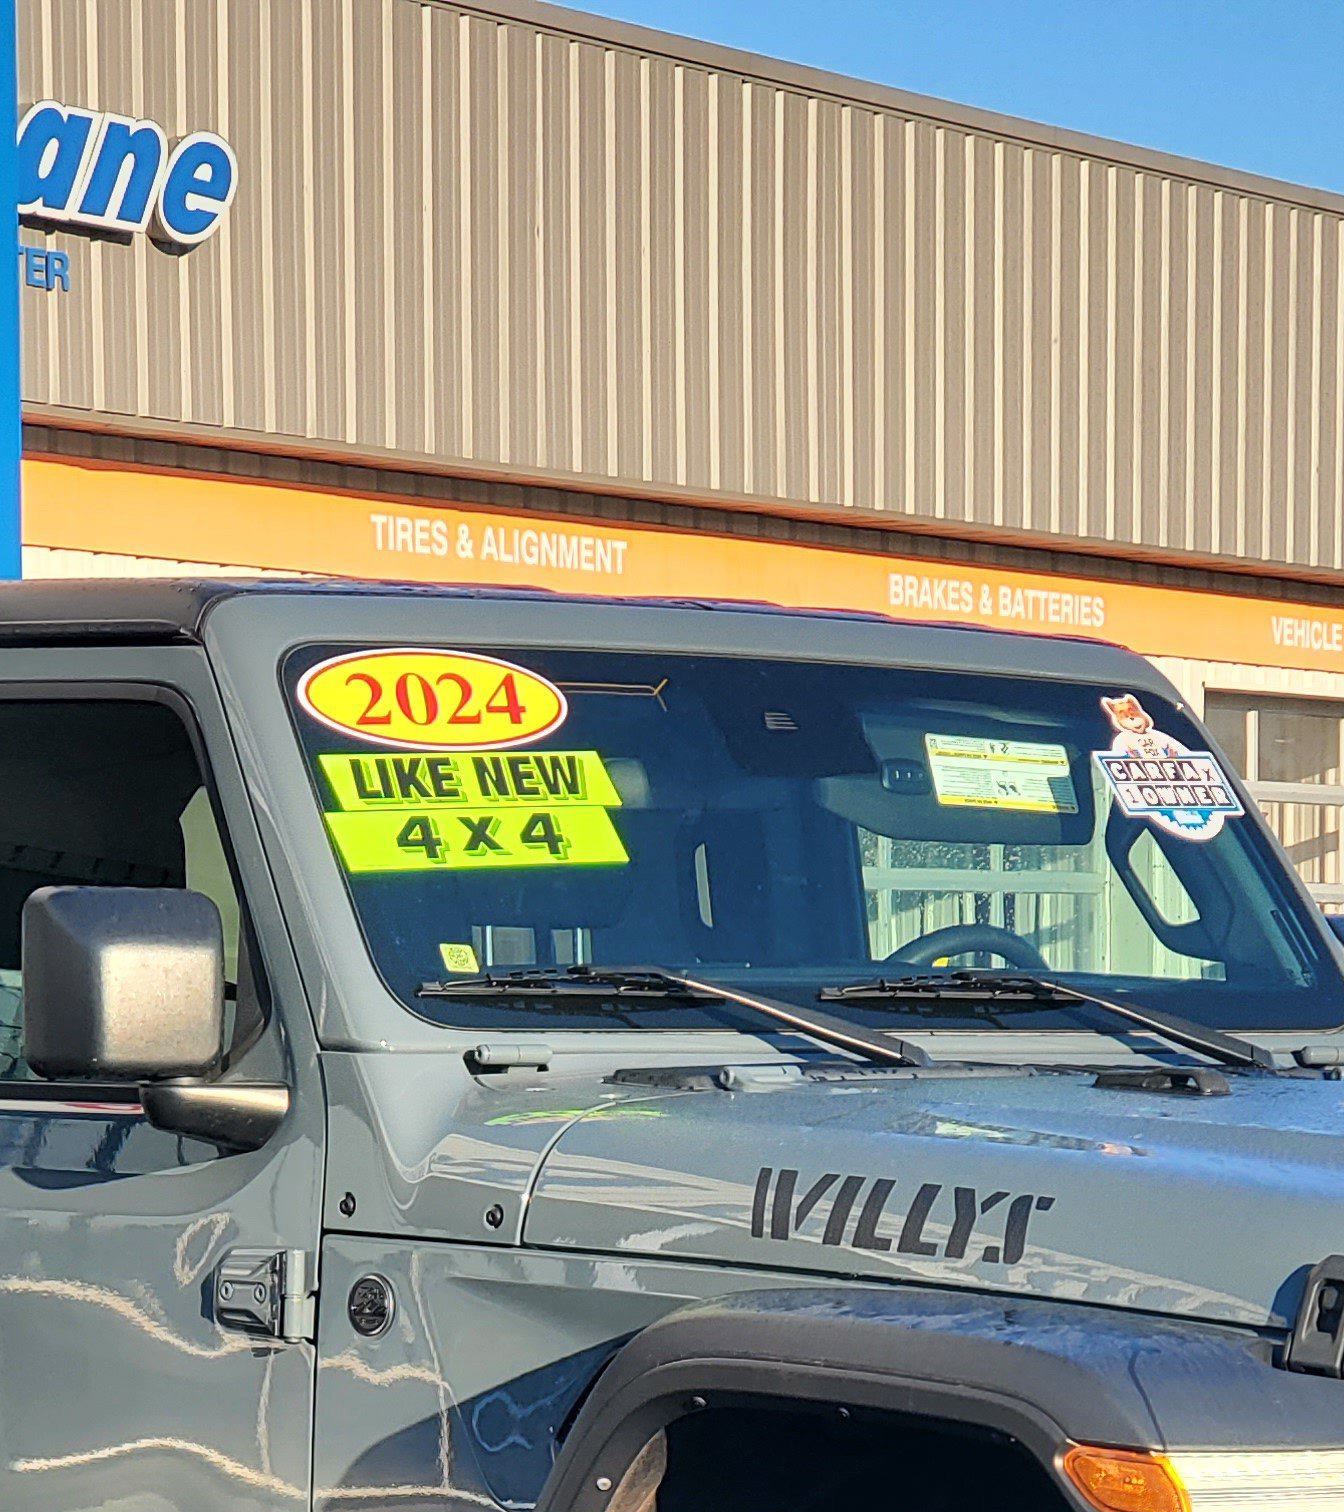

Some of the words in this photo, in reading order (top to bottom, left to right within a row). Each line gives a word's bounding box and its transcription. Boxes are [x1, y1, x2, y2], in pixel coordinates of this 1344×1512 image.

[17, 100, 239, 244] ane
[369, 513, 449, 557] TIRES
[456, 522, 474, 559] &
[481, 525, 628, 575] ALIGNMENT
[888, 573, 974, 614] BRAKES
[979, 583, 993, 616] &
[998, 585, 1105, 628] BATTERIES
[1271, 615, 1343, 652] VEHICLE
[345, 672, 526, 727] 2024
[349, 756, 464, 801] LIKE
[472, 755, 584, 800] NEW
[1107, 761, 1216, 782] CARFAX
[751, 1167, 1056, 1265] WILLYS
